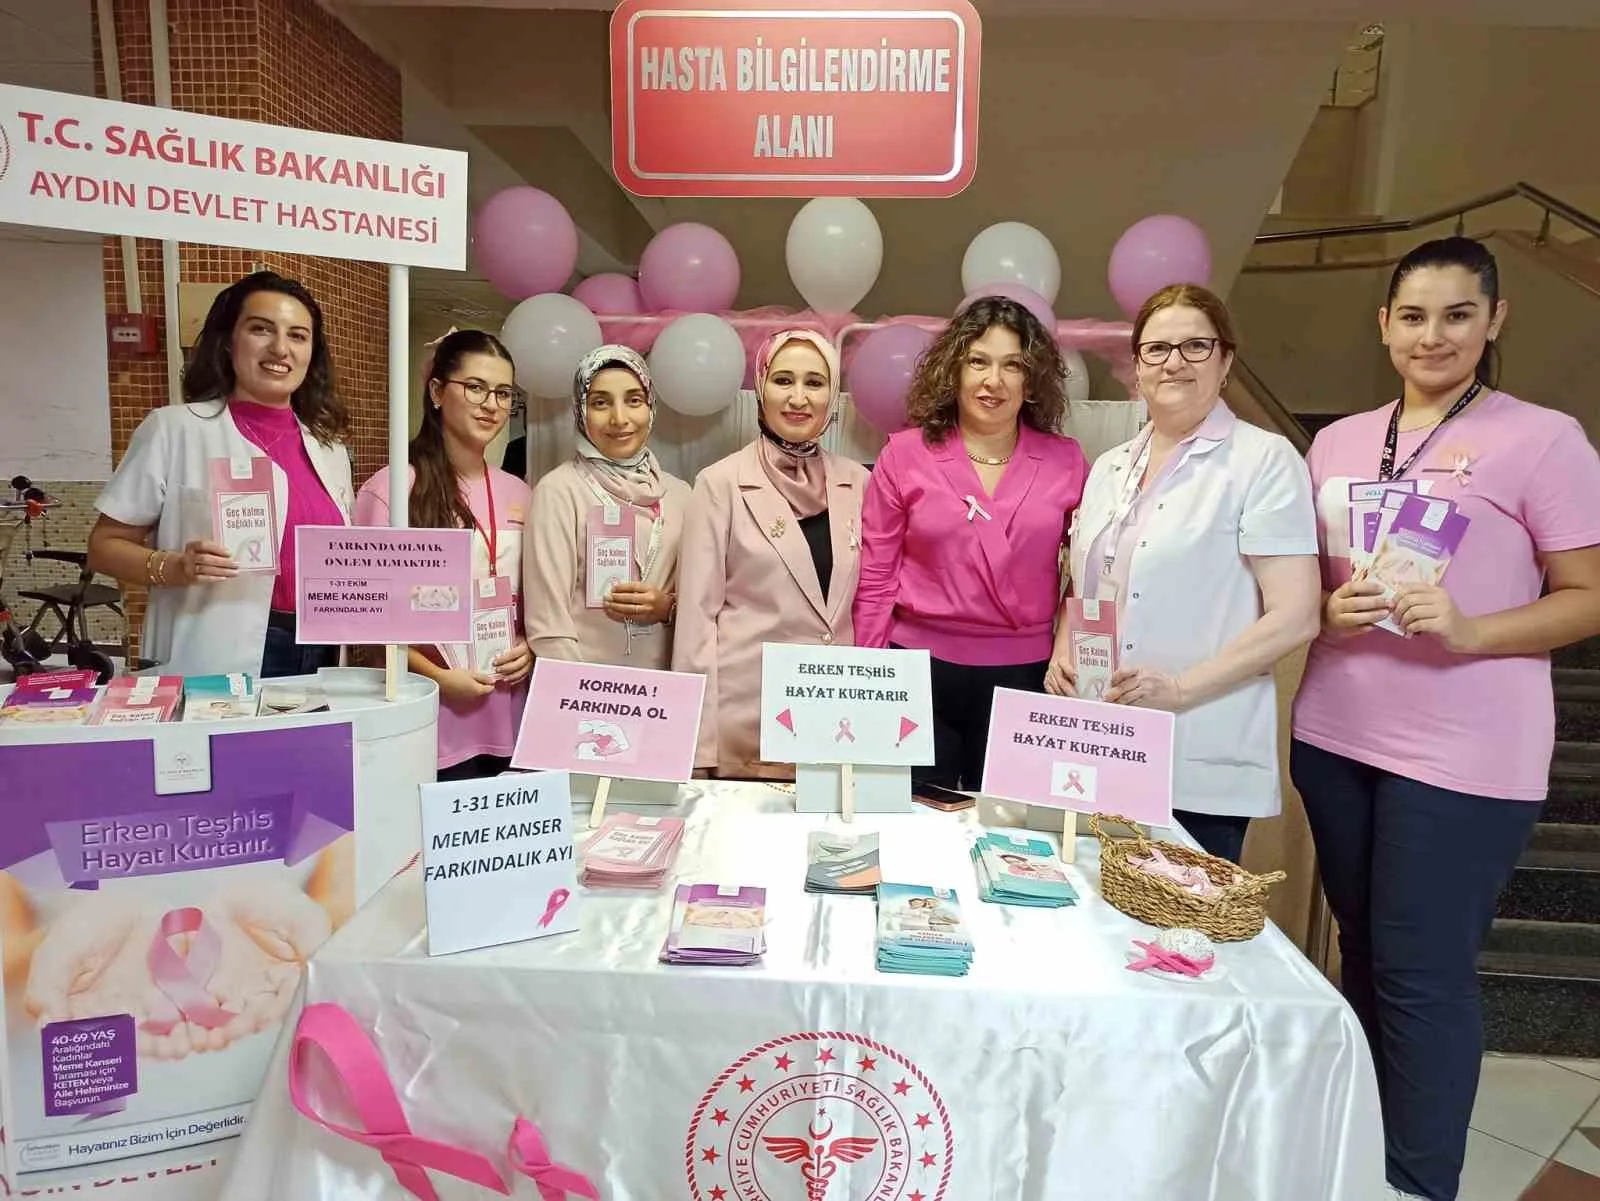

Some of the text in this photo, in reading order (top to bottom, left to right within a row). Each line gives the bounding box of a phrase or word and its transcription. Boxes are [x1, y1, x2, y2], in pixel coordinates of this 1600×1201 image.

[641, 36, 950, 92] HASTA BİLGİLENDİRME
[753, 114, 834, 158] ALANI
[18, 111, 446, 198] T.C. SAĞLIK BAKANLIĞI
[30, 170, 438, 244] AYDIN DEVLET HASTANESİ
[242, 506, 265, 517] Kalma
[329, 541, 443, 552] FARKINDA OLMAK
[308, 591, 388, 601] MEME KANSERİ
[314, 606, 384, 614] FARKINDALIK AYI
[799, 663, 896, 679] ERKEN TEŞHİS
[579, 679, 648, 697] KORKMA
[786, 685, 909, 702] HAYAT KURTARIR
[559, 698, 668, 720] FARKINDA OL
[1029, 711, 1135, 737] ERKEN TEŞHİS
[1013, 732, 1147, 763] HAYAT KURTARIR
[452, 788, 539, 813] 1-31 EKİM
[82, 810, 272, 845] Erken Teşhis
[432, 818, 562, 850] MEME KANSER
[82, 837, 272, 871] Hayat Kurtarır.
[424, 845, 573, 882] FARKINDALIK AYI
[51, 1029, 116, 1046] 40-69 YAŞ
[53, 1052, 93, 1063] Kadınlar
[53, 1056, 122, 1072] Meme Kanseri
[53, 1070, 97, 1081] Taraması
[53, 1076, 113, 1090] KETEM veya
[55, 1089, 74, 1098] Aile
[736, 1077, 840, 1151] CUMHURİYETİ
[845, 1083, 898, 1133] SAĞLIK
[69, 1138, 127, 1155] Hayatınız
[130, 1132, 163, 1146] Bizim
[166, 1127, 186, 1140] İçin
[189, 1115, 247, 1134] Değerlidir.
